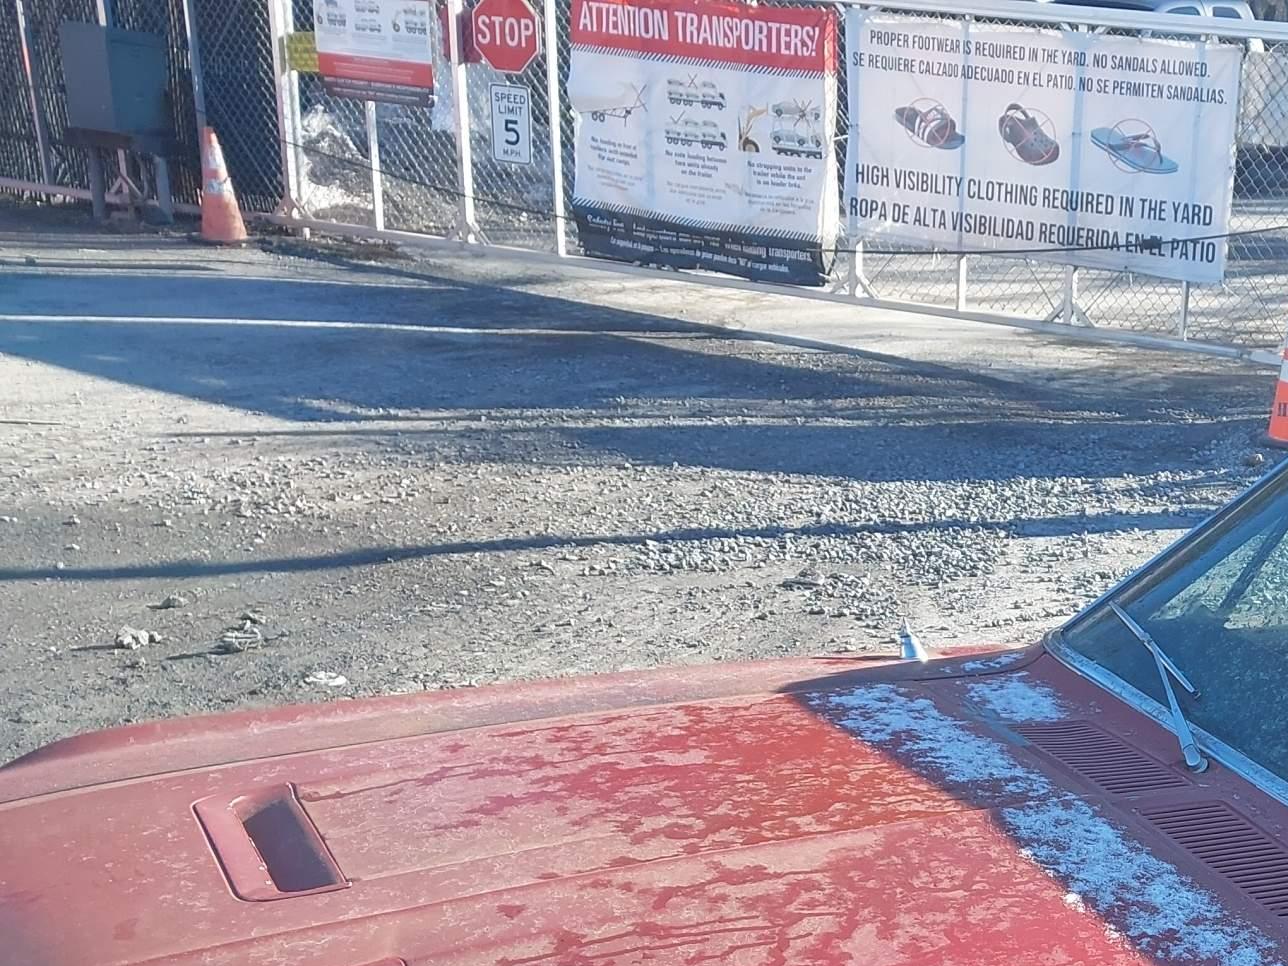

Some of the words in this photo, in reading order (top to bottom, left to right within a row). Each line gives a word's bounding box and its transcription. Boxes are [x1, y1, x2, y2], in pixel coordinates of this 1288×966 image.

[477, 15, 534, 48] STOP
[579, 0, 669, 40] ATTENTION
[674, 11, 819, 56] TRANSPORTERS!
[853, 51, 865, 67] SE
[868, 54, 916, 73] REQUIERE
[918, 61, 959, 78] CALZADO
[961, 64, 1014, 84] ADECUADO
[1017, 71, 1029, 86] EN
[1032, 72, 1044, 87] EL
[1046, 74, 1076, 91] PATIO.
[1078, 77, 1093, 92] NO
[1096, 78, 1110, 94] SE
[1112, 80, 1164, 100] PERMITEN
[1166, 85, 1228, 105] SANDALIAS.
[870, 30, 909, 49] PROPER
[912, 34, 961, 54] FOOTWEAR
[962, 39, 972, 55] IS
[975, 41, 1025, 62] REQUIRED
[1028, 46, 1038, 62] IN
[1041, 48, 1058, 64] THE
[1062, 50, 1089, 68] YARD.
[1093, 53, 1108, 69] NO
[1110, 55, 1158, 74] SANDALS
[1160, 59, 1211, 78] ALLOWED.
[494, 91, 526, 105] SPEED
[498, 105, 523, 117] LIMIT
[504, 119, 520, 146] 5
[855, 163, 890, 187] HIGH
[894, 168, 963, 197] VISIBILITY
[967, 178, 1038, 207] CLOTHING
[1042, 187, 1114, 216] REQUIRED
[1119, 195, 1135, 218] IN
[1139, 198, 1167, 221] THE
[1172, 201, 1213, 227] YARD
[850, 197, 887, 221] ROPA
[892, 202, 910, 225] DE
[913, 206, 946, 230] ALTA
[951, 211, 1035, 241] VISIBILIDAD
[1039, 222, 1120, 252] REQUERIDA
[1125, 232, 1144, 254] EN
[1170, 238, 1216, 263] PATIO
